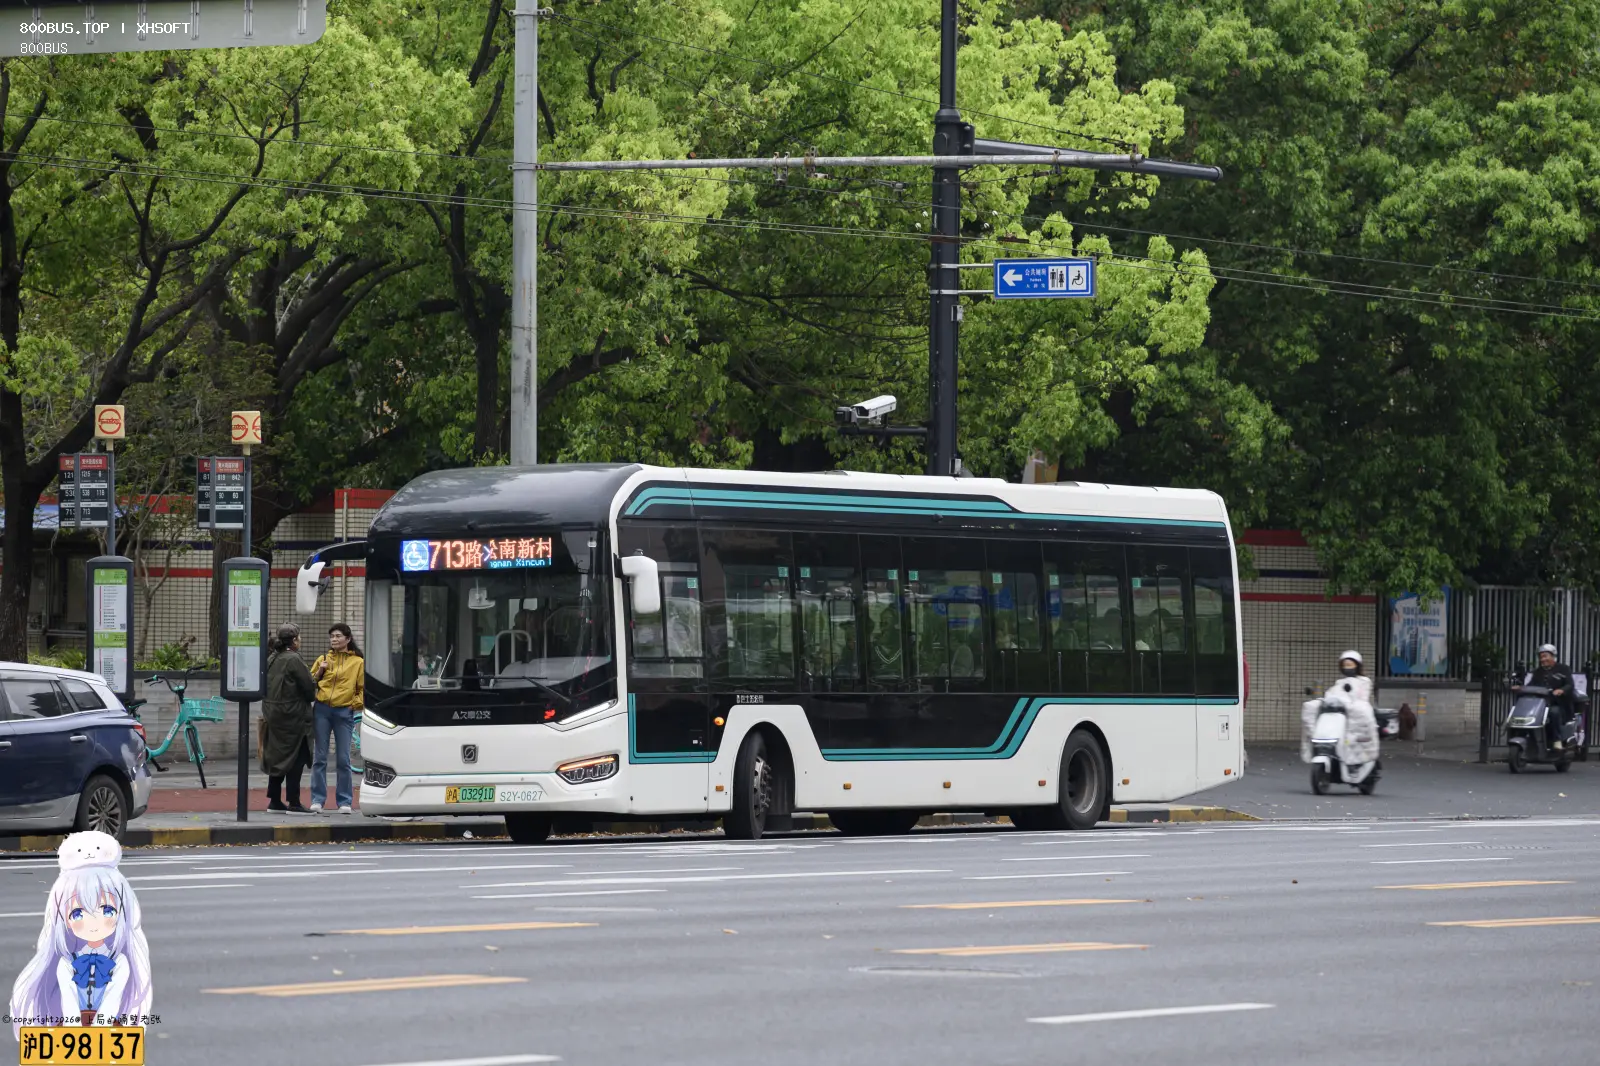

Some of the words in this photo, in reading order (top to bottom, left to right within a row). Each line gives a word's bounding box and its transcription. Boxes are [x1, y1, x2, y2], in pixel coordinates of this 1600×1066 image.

[428, 540, 484, 569] 713路
[515, 558, 545, 567] Xincun
[500, 790, 543, 802] S2Y-0627
